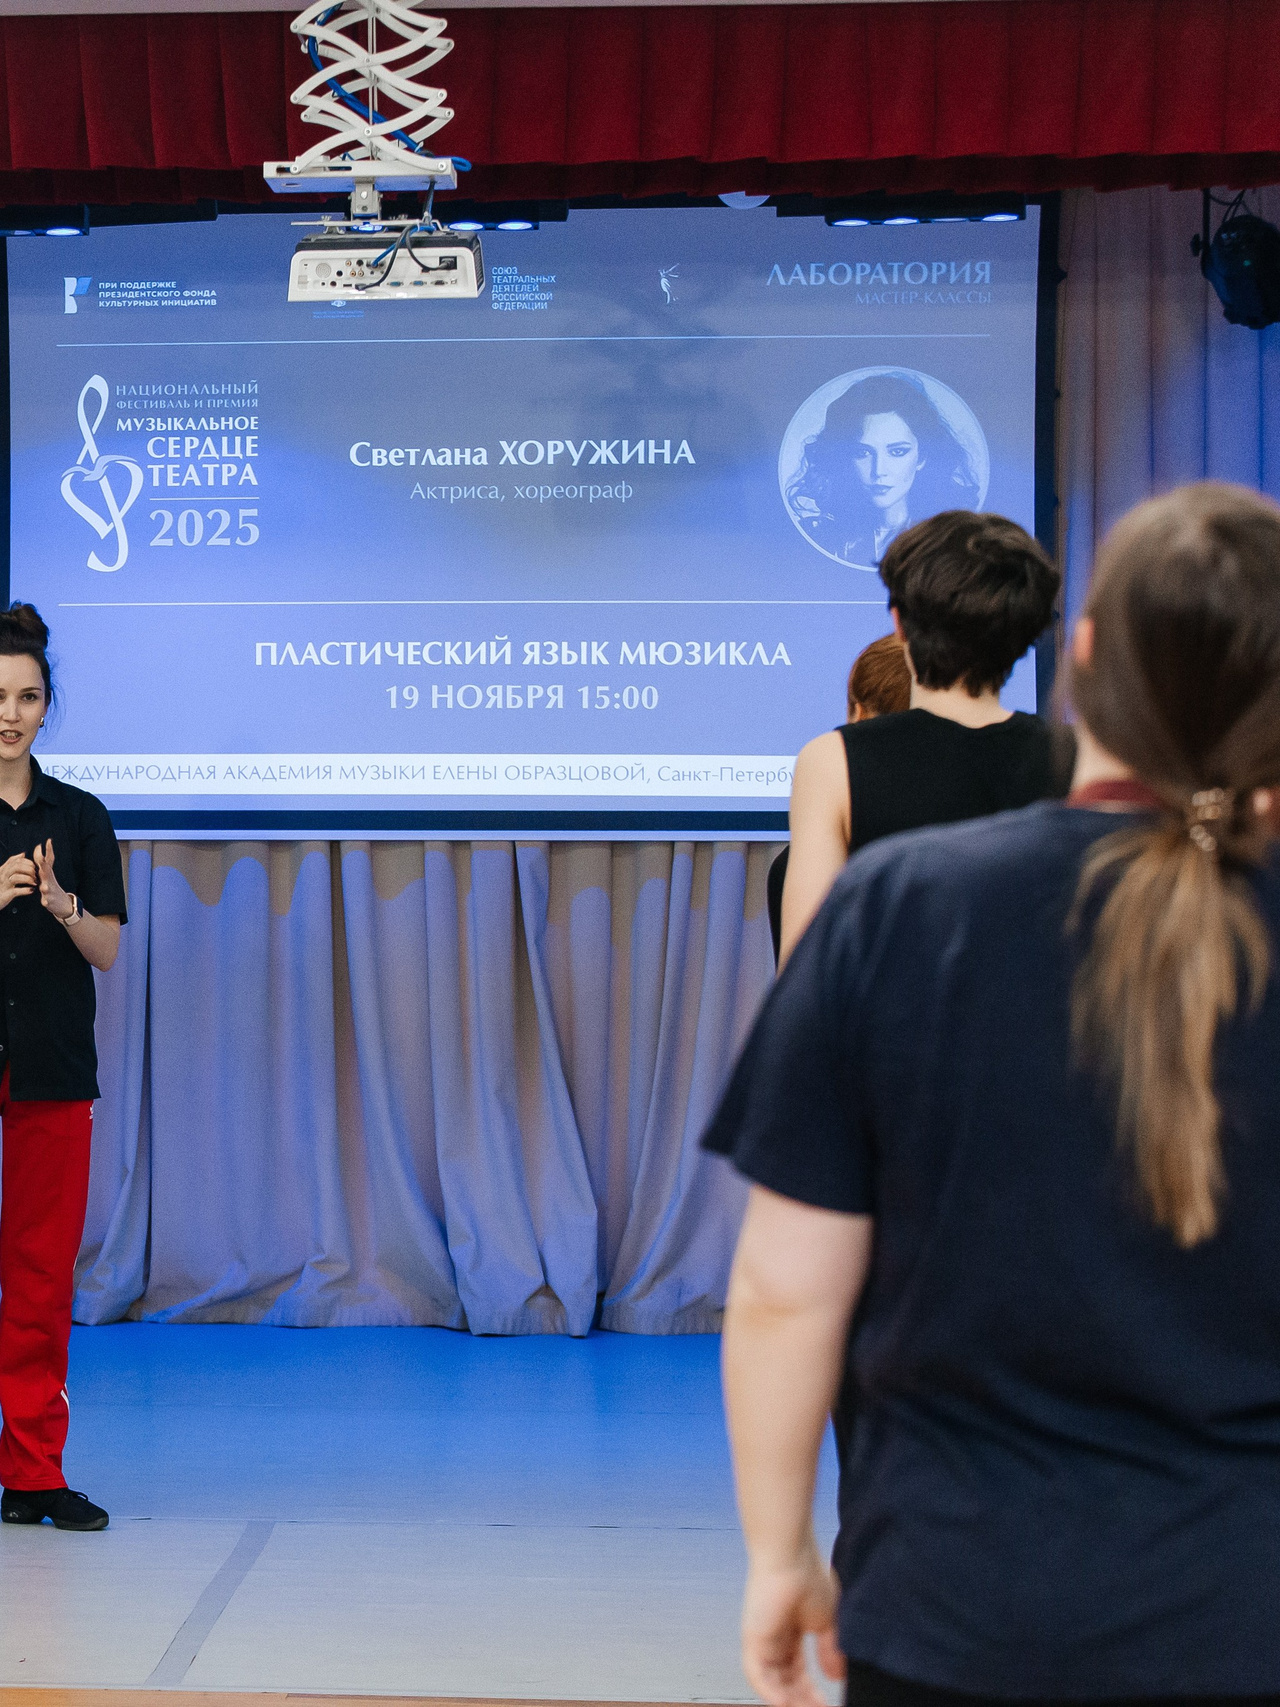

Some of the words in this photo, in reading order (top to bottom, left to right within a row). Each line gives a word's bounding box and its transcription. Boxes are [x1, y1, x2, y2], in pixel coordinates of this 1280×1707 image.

[491, 266, 518, 275] СОЮЗ
[766, 261, 991, 286] ЛАБОРАТОРИЯ
[120, 281, 177, 289] ПОДДЕРЖКЕ
[491, 275, 556, 284] ТЕАТРАЛЬНЫХ
[99, 290, 181, 298] ПРЕЗИДЕНТСКОГО
[182, 290, 217, 298] ФОНДА
[491, 283, 539, 293] ДЕЯТЕЛЕЙ
[491, 291, 553, 301] РОССИЙСКОЙ
[99, 300, 159, 308] КУЛЬТУРНЫХ
[161, 299, 217, 307] ИНИЦИАТИВ
[491, 302, 548, 311] ФЕДЕРАЦИИ
[116, 379, 258, 396] НАЦИОНАЛЬНЫЙ
[116, 399, 191, 410] ФЕСТИВАЛЬ
[194, 400, 203, 408] И
[207, 399, 258, 408] ПРЕМИЯ
[116, 416, 259, 432] МУЗЫКАЛЬНОЕ
[146, 436, 259, 460] СЕРДЦЕ
[349, 441, 488, 467] Светлана
[498, 439, 696, 466] ХОРУЖИНА
[147, 463, 259, 487] ТЕАТРА
[410, 482, 505, 503] Актриса,
[513, 480, 633, 503] хореограф
[149, 508, 260, 547] 2025
[255, 635, 512, 666] ПЛАСТИЧЕСКИЙ
[523, 641, 609, 666] ЯЗЫК
[620, 641, 792, 667] МЮЗИКЛА
[385, 685, 419, 710] 19
[430, 684, 565, 710] НОЯБРЯ
[578, 685, 659, 710] 15:00
[223, 764, 332, 782] АКАДЕМИЯ
[339, 764, 425, 781] МУЗЫКИ
[433, 764, 497, 781] ЕЛЕНЫ
[504, 762, 651, 784] ОБРАЗЦОВОЙ,
